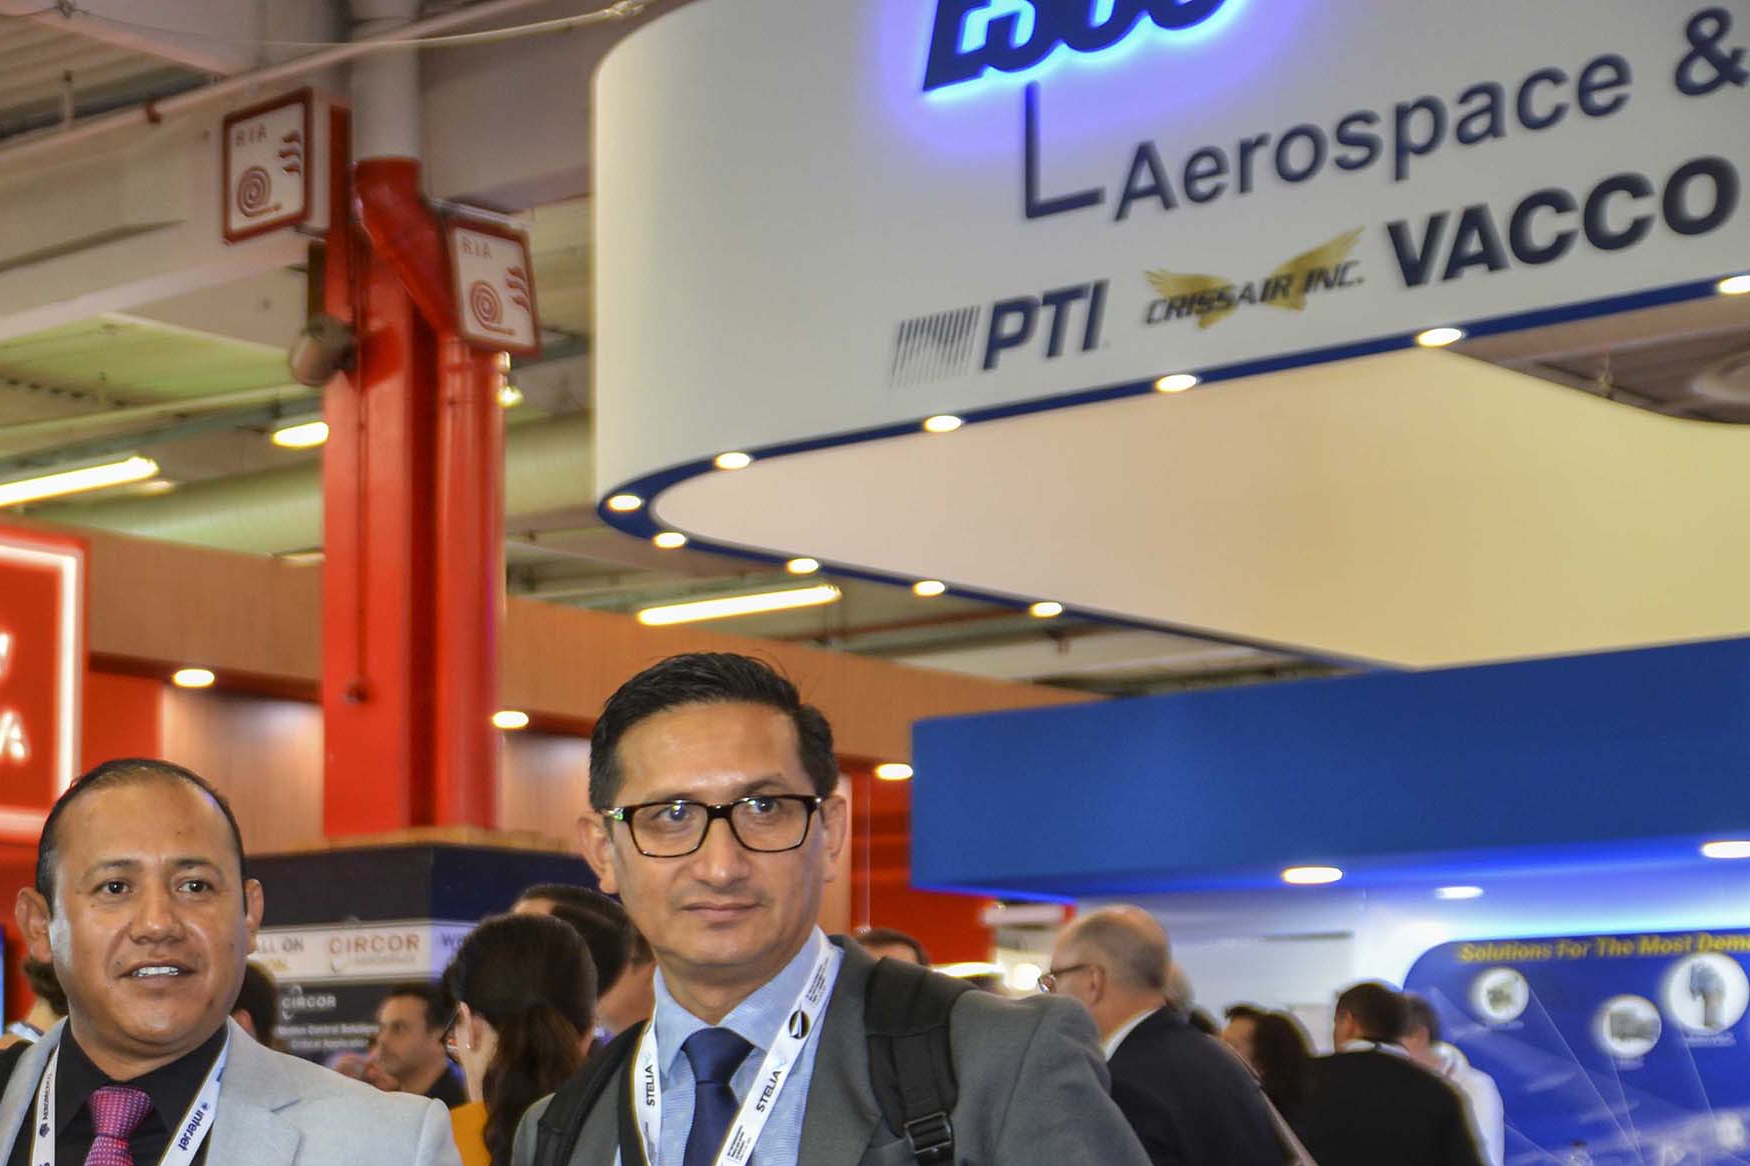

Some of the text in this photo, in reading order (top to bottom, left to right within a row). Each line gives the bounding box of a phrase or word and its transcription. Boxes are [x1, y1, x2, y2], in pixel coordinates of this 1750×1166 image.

[1115, 8, 1750, 223] Aerospace &
[1386, 156, 1741, 289] VACCO
[1145, 259, 1364, 325] CRISSAIR INC.
[983, 279, 1109, 371] PTI
[329, 933, 421, 955] CIRCOR
[1459, 942, 1550, 962] Solutions
[1556, 940, 1590, 959] For
[1596, 937, 1635, 956] The
[1638, 935, 1692, 954] Most
[281, 994, 338, 1009] CIRCOR
[646, 1064, 655, 1107] STELIA
[756, 1069, 783, 1113] STELIA
